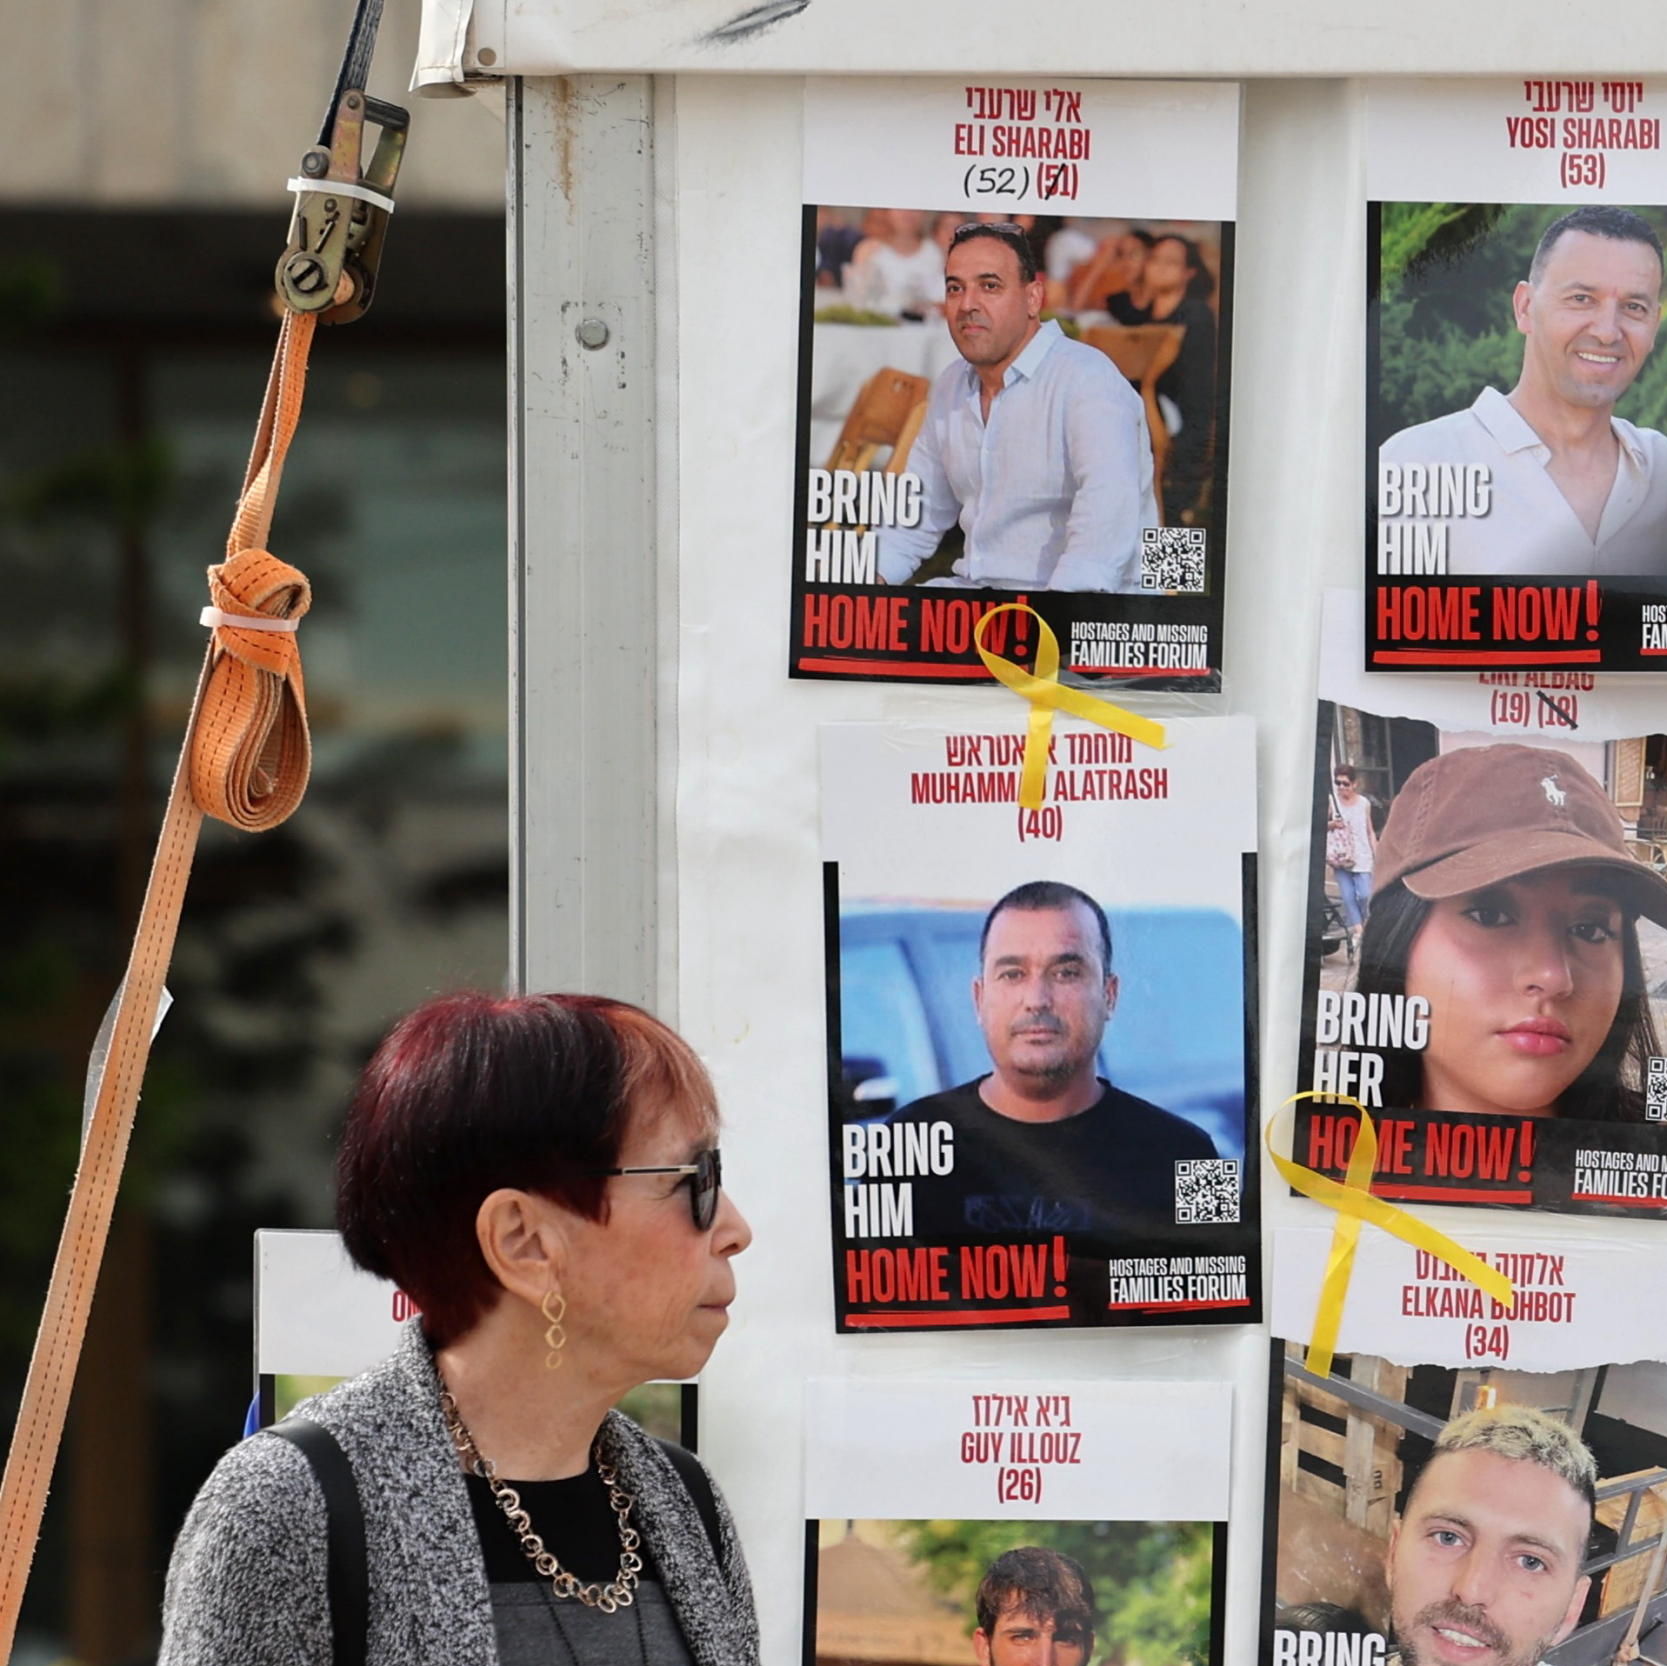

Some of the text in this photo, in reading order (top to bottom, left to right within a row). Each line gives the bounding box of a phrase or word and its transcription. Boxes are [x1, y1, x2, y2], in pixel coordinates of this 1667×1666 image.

[965, 87, 1082, 124] אלי שרעבי
[955, 124, 1090, 160] ELI SHARABI
[1507, 117, 1661, 150] YOSI SHARABI
[964, 164, 1029, 200] (52)
[1560, 154, 1606, 187] (53)
[1379, 462, 1492, 517] BRING
[1377, 522, 1447, 575] HIM
[1376, 579, 1599, 642] HOME NOW!
[911, 768, 1168, 804] MUHAMM ALATRASH
[1402, 1285, 1485, 1319] ELKANA
[961, 1432, 1083, 1464] GUY ILLOUZ
[997, 1468, 1043, 1503] (26)
